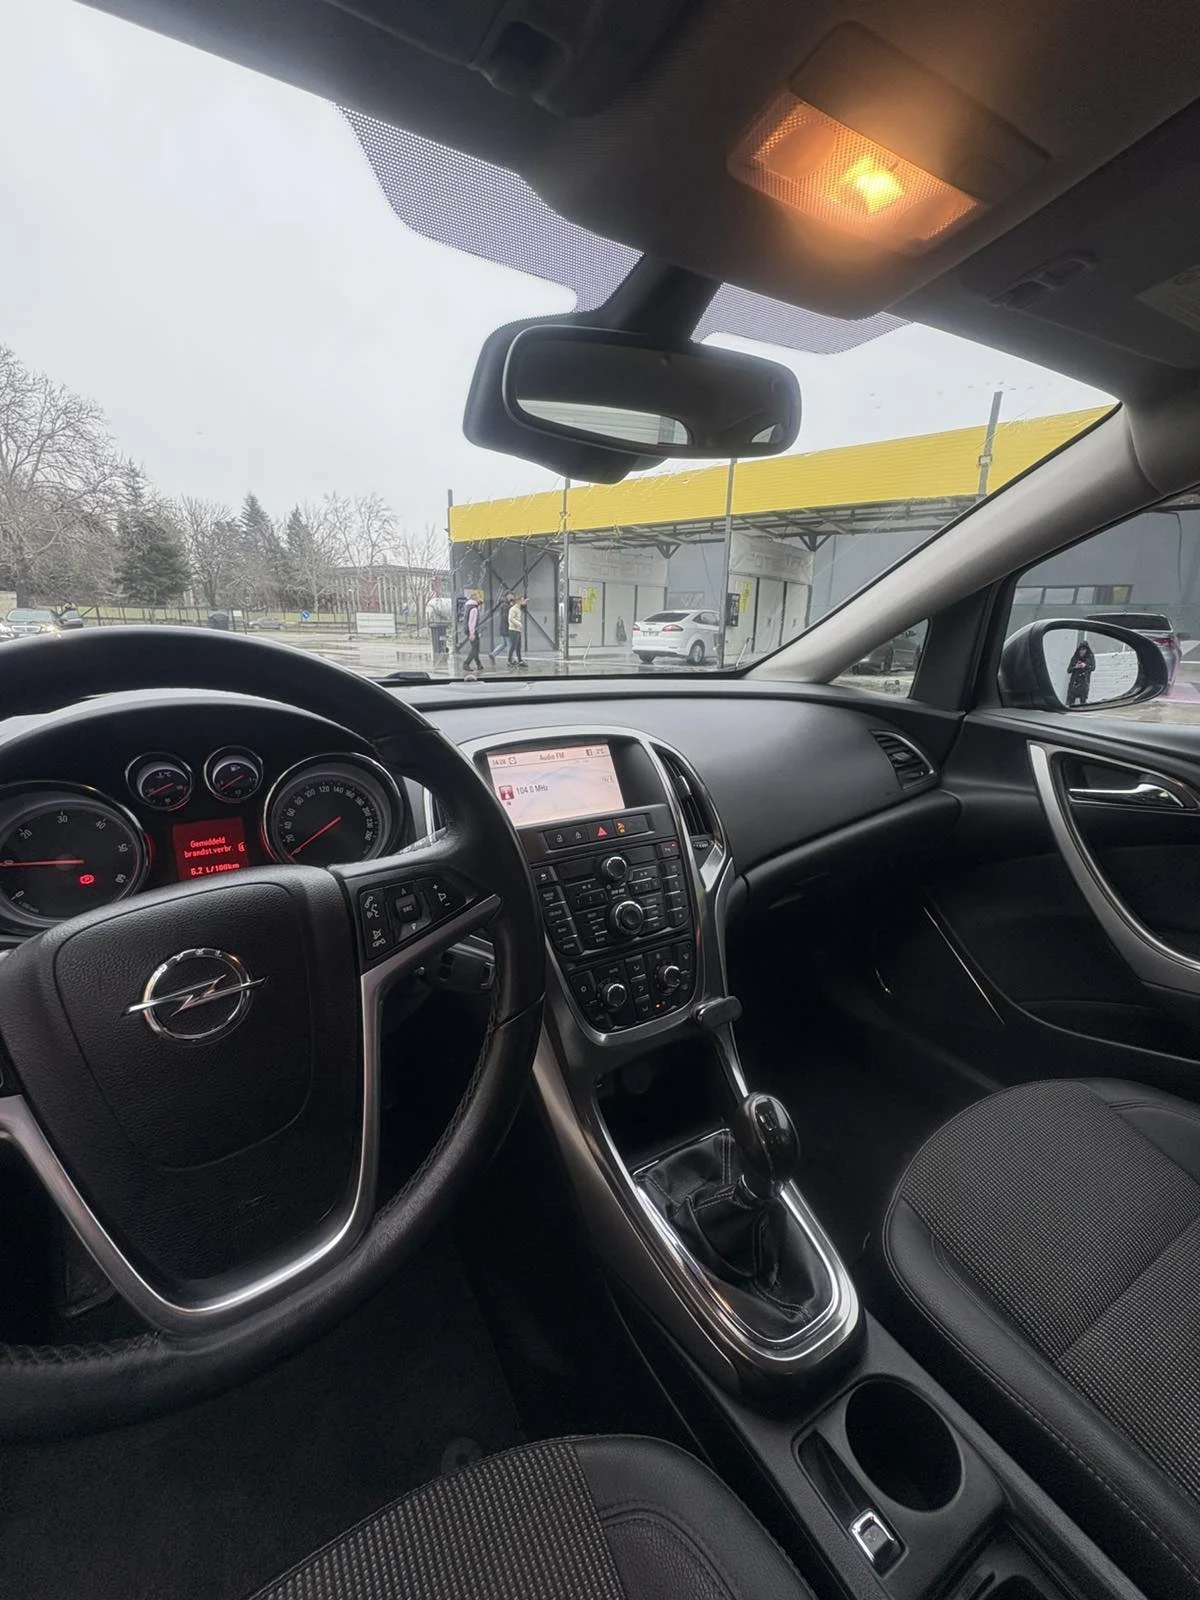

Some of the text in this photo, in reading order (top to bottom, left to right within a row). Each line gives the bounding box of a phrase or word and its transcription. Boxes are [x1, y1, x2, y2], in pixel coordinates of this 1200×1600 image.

[57, 815, 68, 823] 30
[95, 821, 106, 830] 40
[21, 828, 33, 840] 20
[190, 836, 226, 848] Gemiddeld
[190, 866, 204, 876] 6.2
